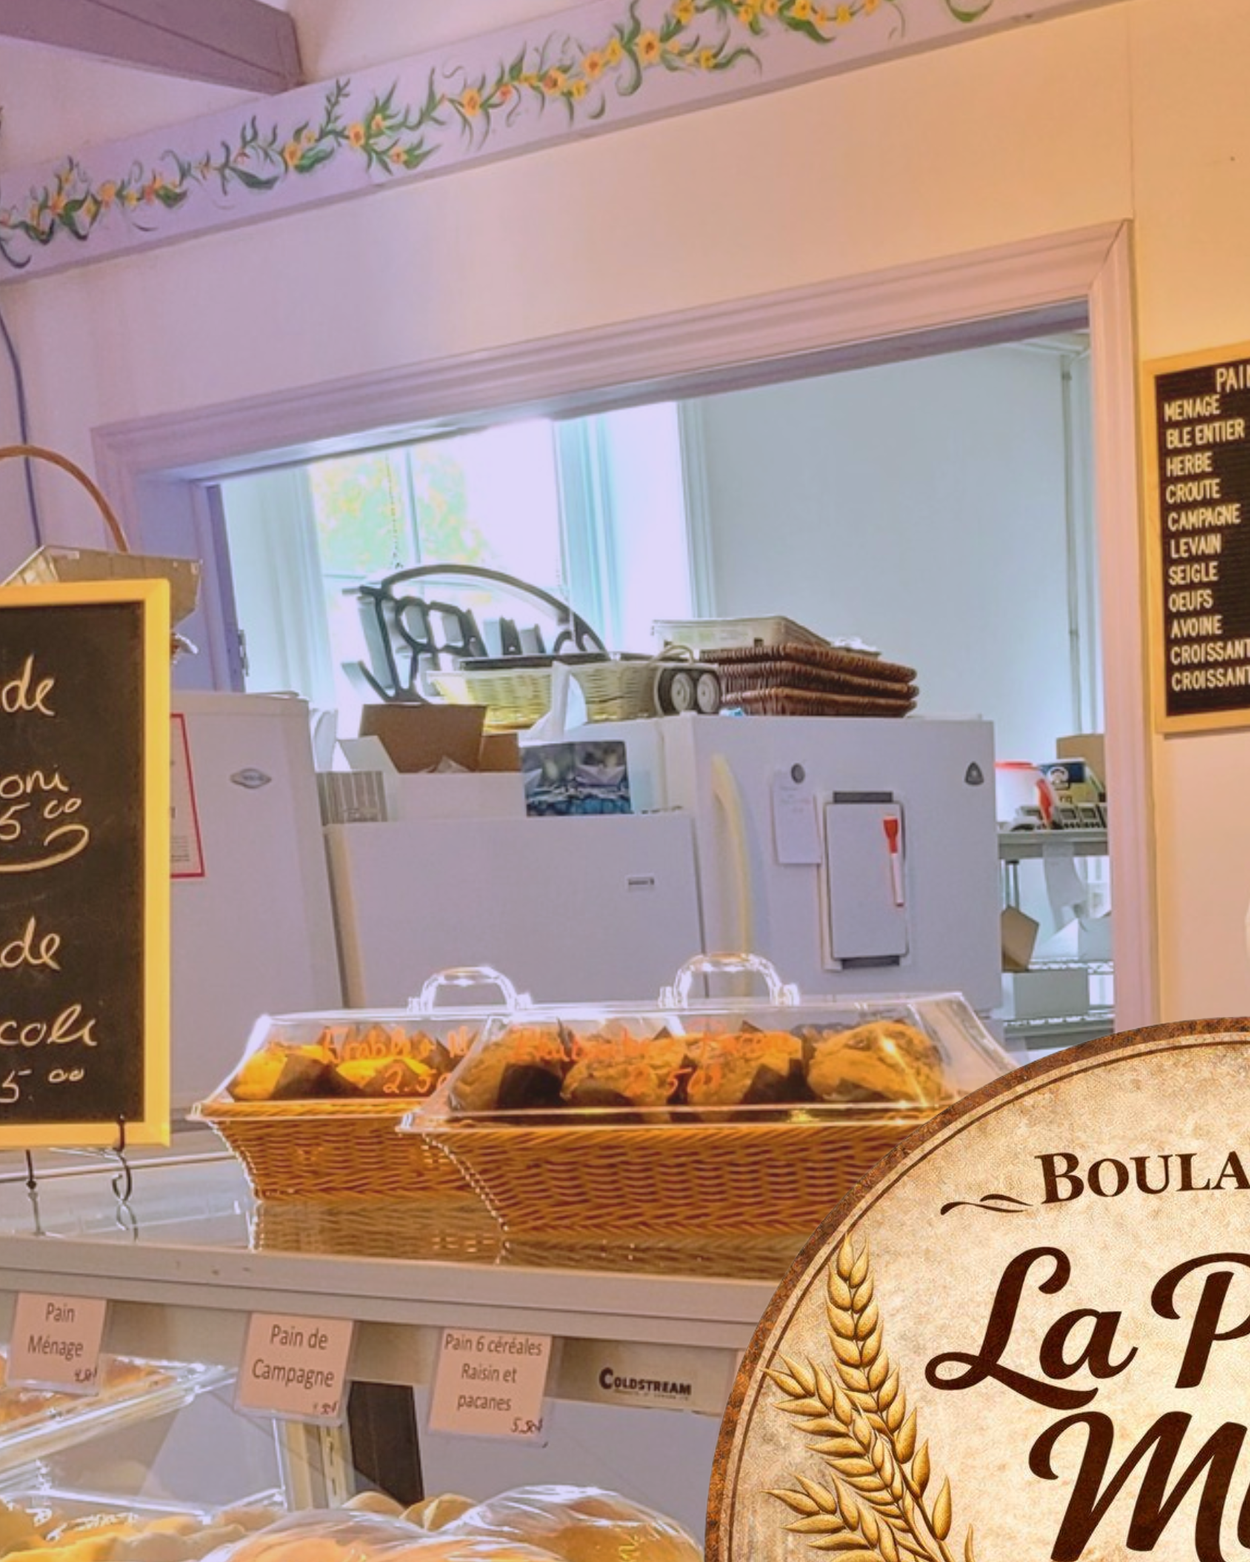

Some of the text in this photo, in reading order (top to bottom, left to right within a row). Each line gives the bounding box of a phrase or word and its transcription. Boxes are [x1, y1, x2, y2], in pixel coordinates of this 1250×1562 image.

[1164, 394, 1221, 422] MENAGE
[1166, 418, 1245, 449] BLE ENTIER
[1166, 452, 1213, 477] HERBE
[1166, 478, 1221, 504] CROUTE
[1168, 504, 1241, 532] CAMPAGNE
[1170, 533, 1222, 559] LEVAIN
[1168, 561, 1219, 586] SEIGLE
[1168, 589, 1213, 613] OEUFS
[1170, 615, 1223, 639] AVOINE
[1, 653, 56, 716] de
[0, 915, 62, 971] de
[45, 1302, 75, 1324] Pain
[27, 1334, 84, 1359] Ménage
[269, 1324, 329, 1350] Pain de
[444, 1334, 543, 1357] Pain 6 céréales
[252, 1358, 335, 1389] Campagne
[461, 1363, 517, 1384] Raisin et
[457, 1393, 512, 1412] pacanes
